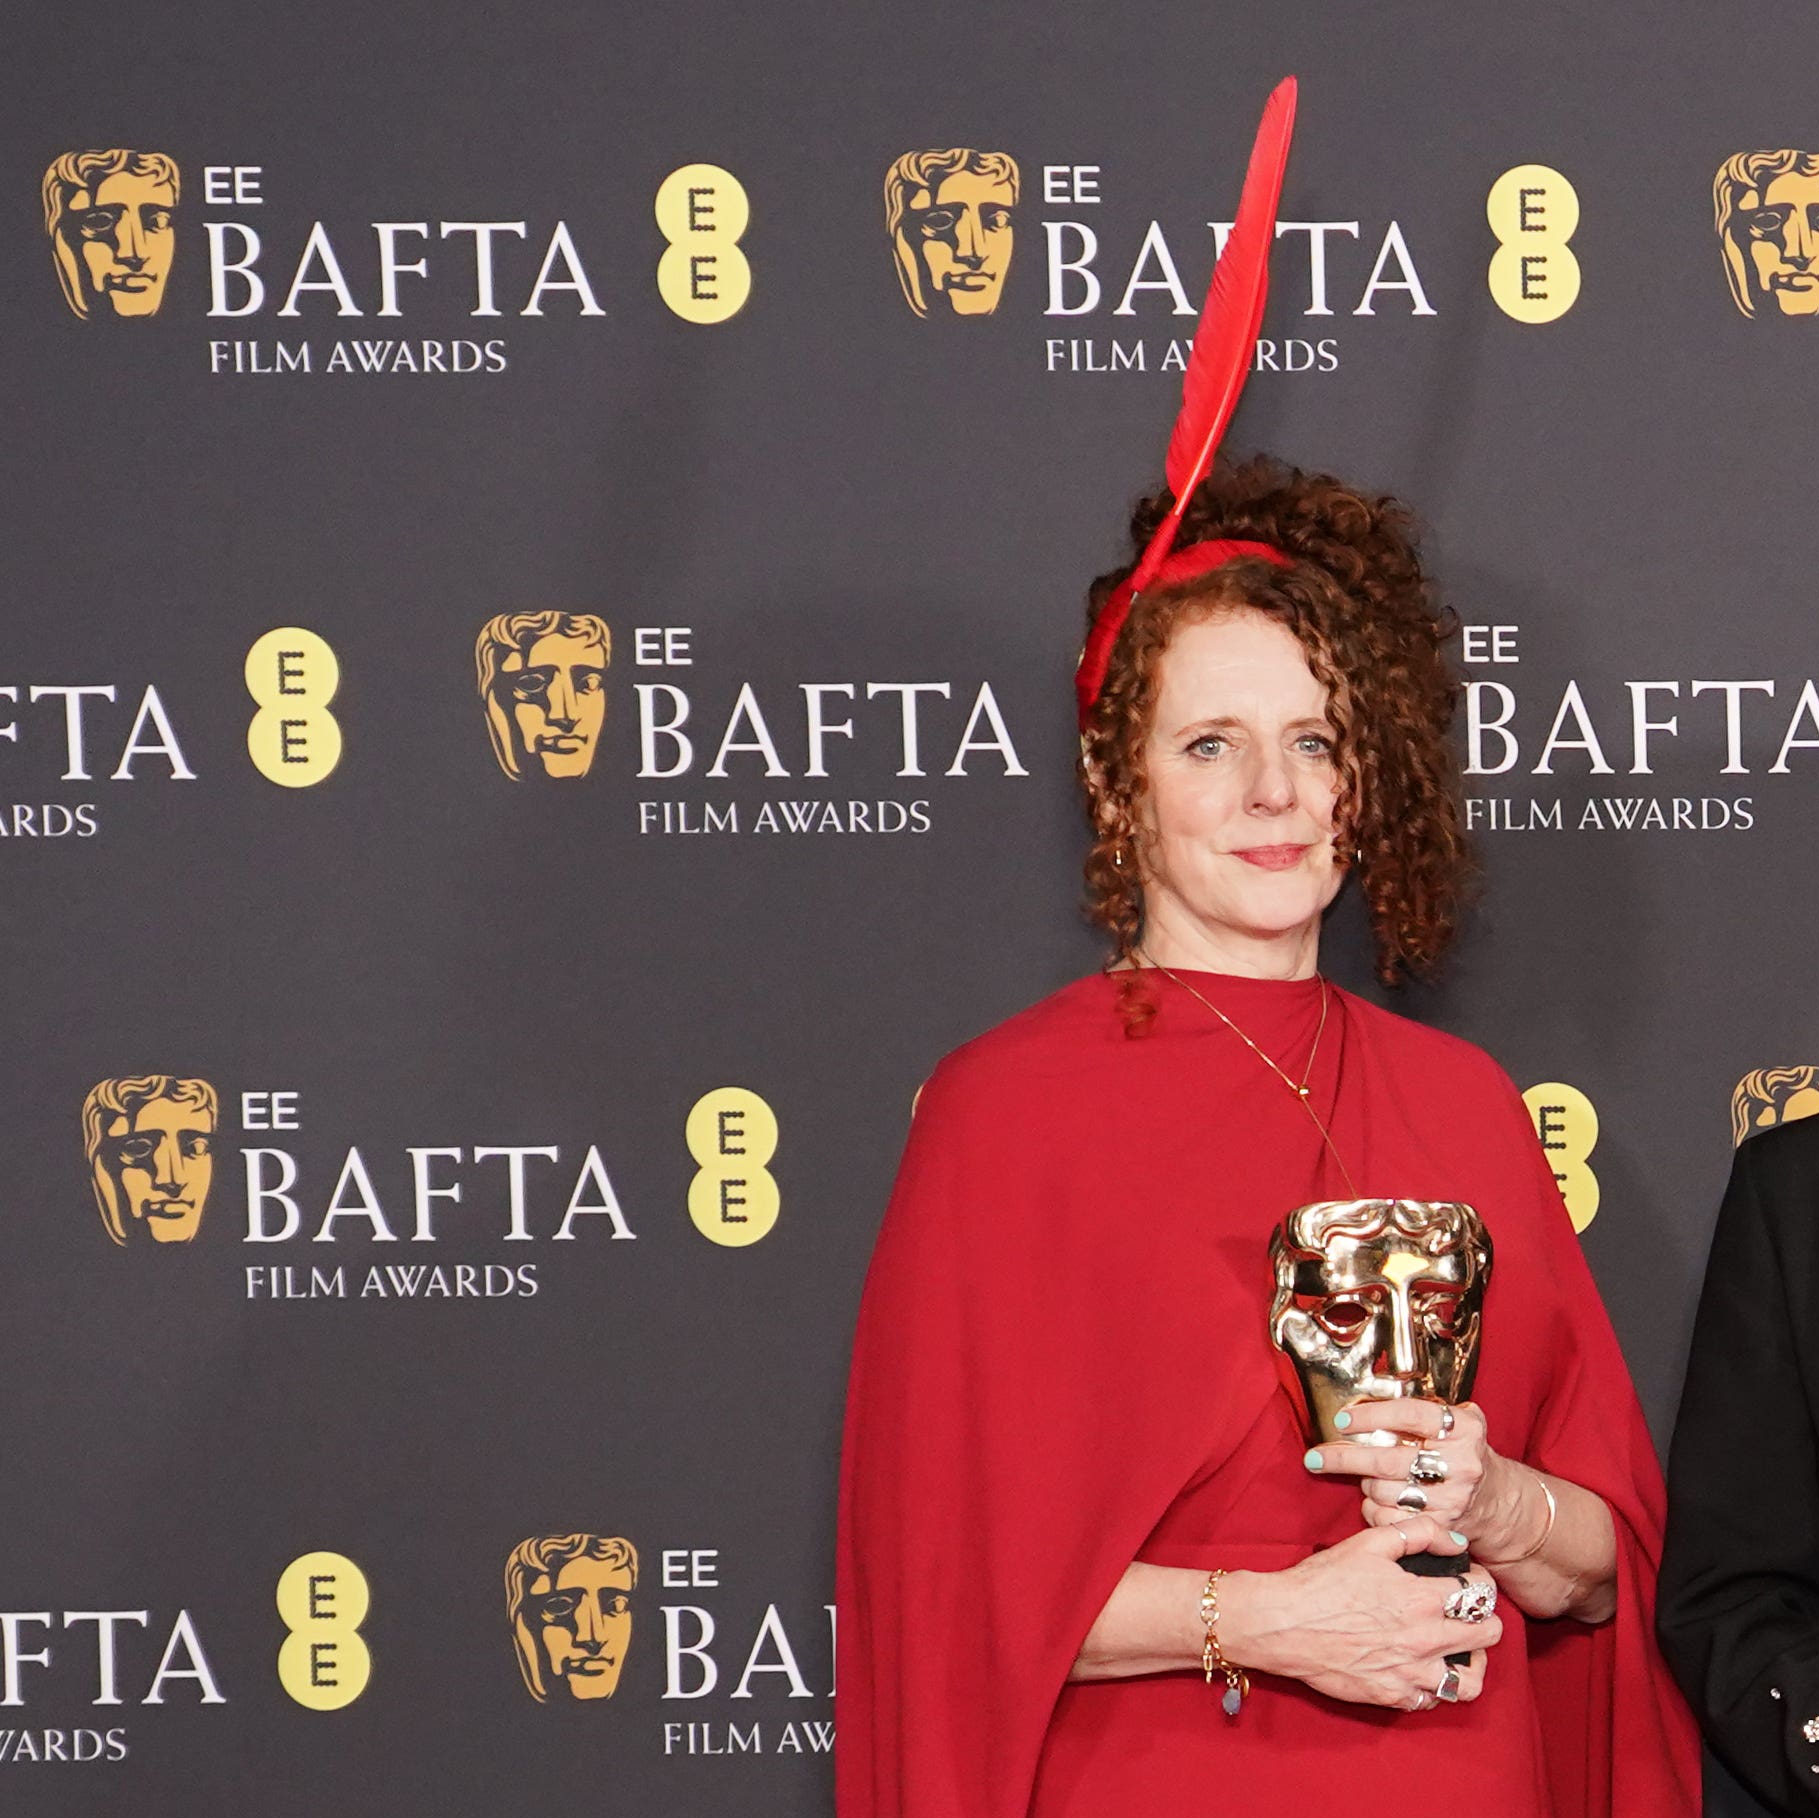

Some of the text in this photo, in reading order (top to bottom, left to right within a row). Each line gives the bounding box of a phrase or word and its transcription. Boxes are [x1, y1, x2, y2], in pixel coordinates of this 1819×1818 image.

[204, 167, 263, 204] EE
[1044, 166, 1100, 203] EE
[203, 221, 606, 316] BAFTA
[210, 340, 506, 373] FILM AWARDS
[1046, 339, 1338, 371] FILM ARDS
[635, 628, 692, 665] EE
[1463, 626, 1519, 662] EE
[0, 685, 197, 780] TA
[633, 682, 1029, 777] BAFTA
[639, 801, 930, 833] FILM AWARDS
[1464, 798, 1753, 830] FILM AWARDS
[242, 1092, 299, 1129] EE
[240, 1145, 637, 1242] BAFTA
[246, 1265, 538, 1298] FILM AWARDS
[663, 1550, 718, 1587] EE
[660, 1604, 836, 1699] BA
[665, 1723, 761, 1754] FILM
